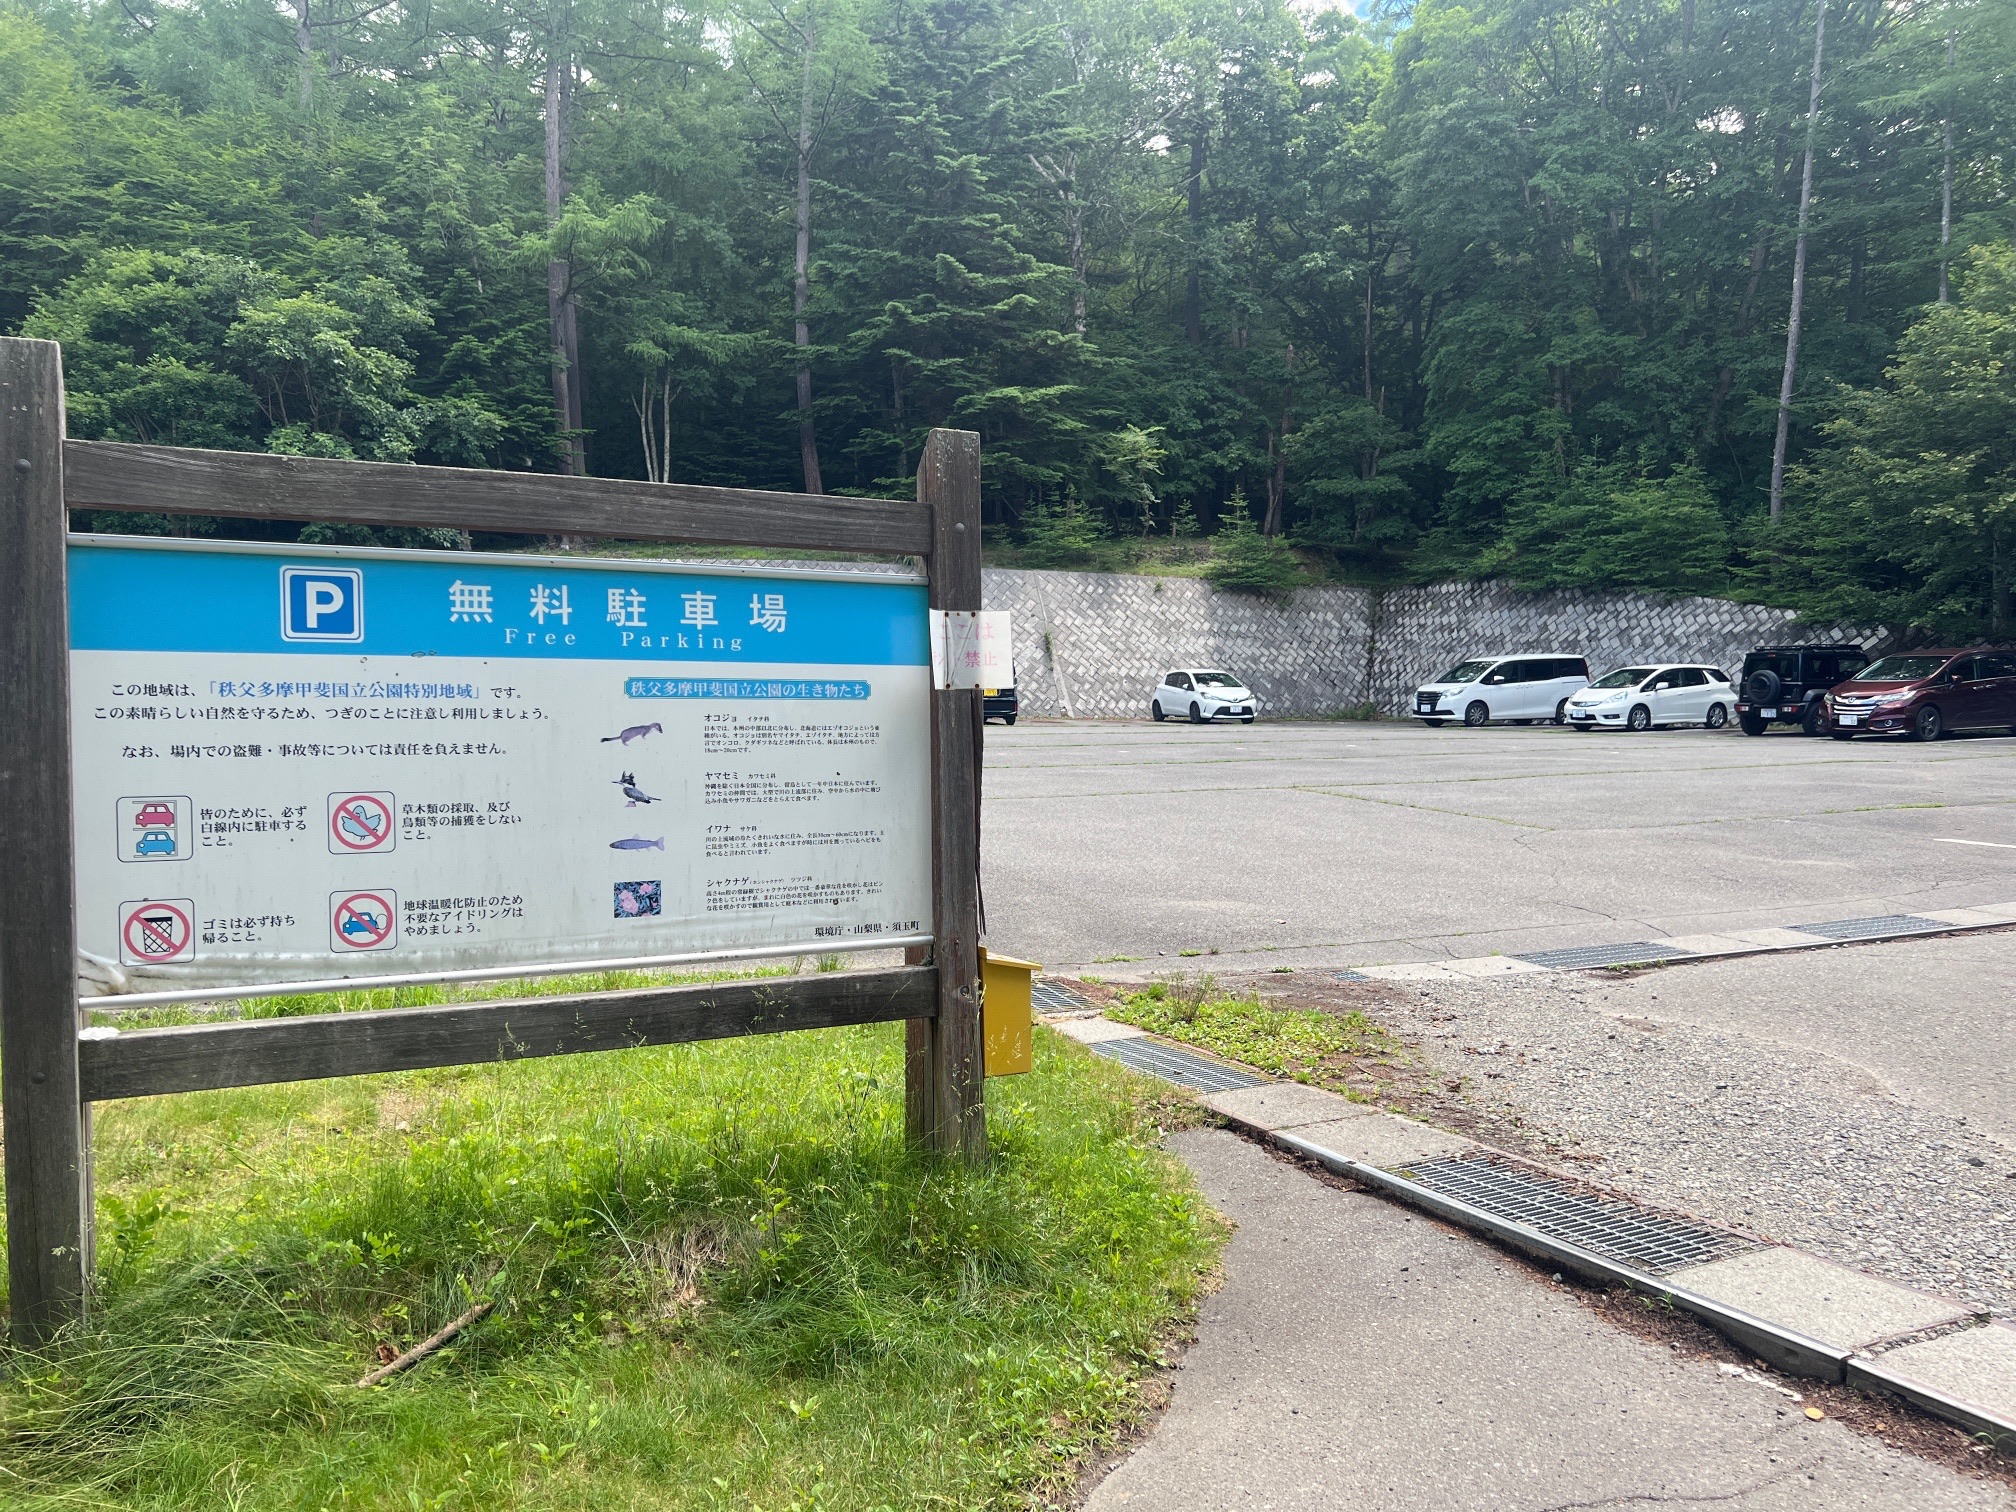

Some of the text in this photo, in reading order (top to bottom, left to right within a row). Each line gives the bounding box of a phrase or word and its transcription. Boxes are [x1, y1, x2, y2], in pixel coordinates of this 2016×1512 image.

[305, 581, 344, 629] P
[448, 579, 787, 634] 無料駐車場
[504, 628, 744, 652] Free Parking
[630, 680, 866, 699] 秩父多摩甲斐国立公園の生き物たち
[93, 704, 551, 722] この素晴らしい自然を守るため、つぎのことに注意し利用しましょう。
[704, 713, 737, 723] オコジョ
[122, 742, 509, 761] なお、場内での盗難・事故等については責任を負えません。
[704, 771, 739, 781] ヤマセミ
[200, 805, 307, 820] 皆のために、必ず
[402, 801, 511, 815] 草木類の採取、及び
[201, 819, 306, 834] 白線内に駐車する
[402, 814, 521, 828] 鳥類等の捕獲をしない
[706, 824, 732, 834] イワナ
[202, 835, 234, 847] こと。
[403, 829, 432, 840] こと。
[403, 895, 523, 911] 地球温暖化防止のため
[202, 914, 295, 930] ゴミは必ず持ち
[403, 907, 524, 924] 不要なアイドリングは
[202, 929, 263, 945] 帰ること。
[403, 922, 482, 937] やめましょう。
[814, 920, 920, 938] 環境庁・山梨県・須玉町
